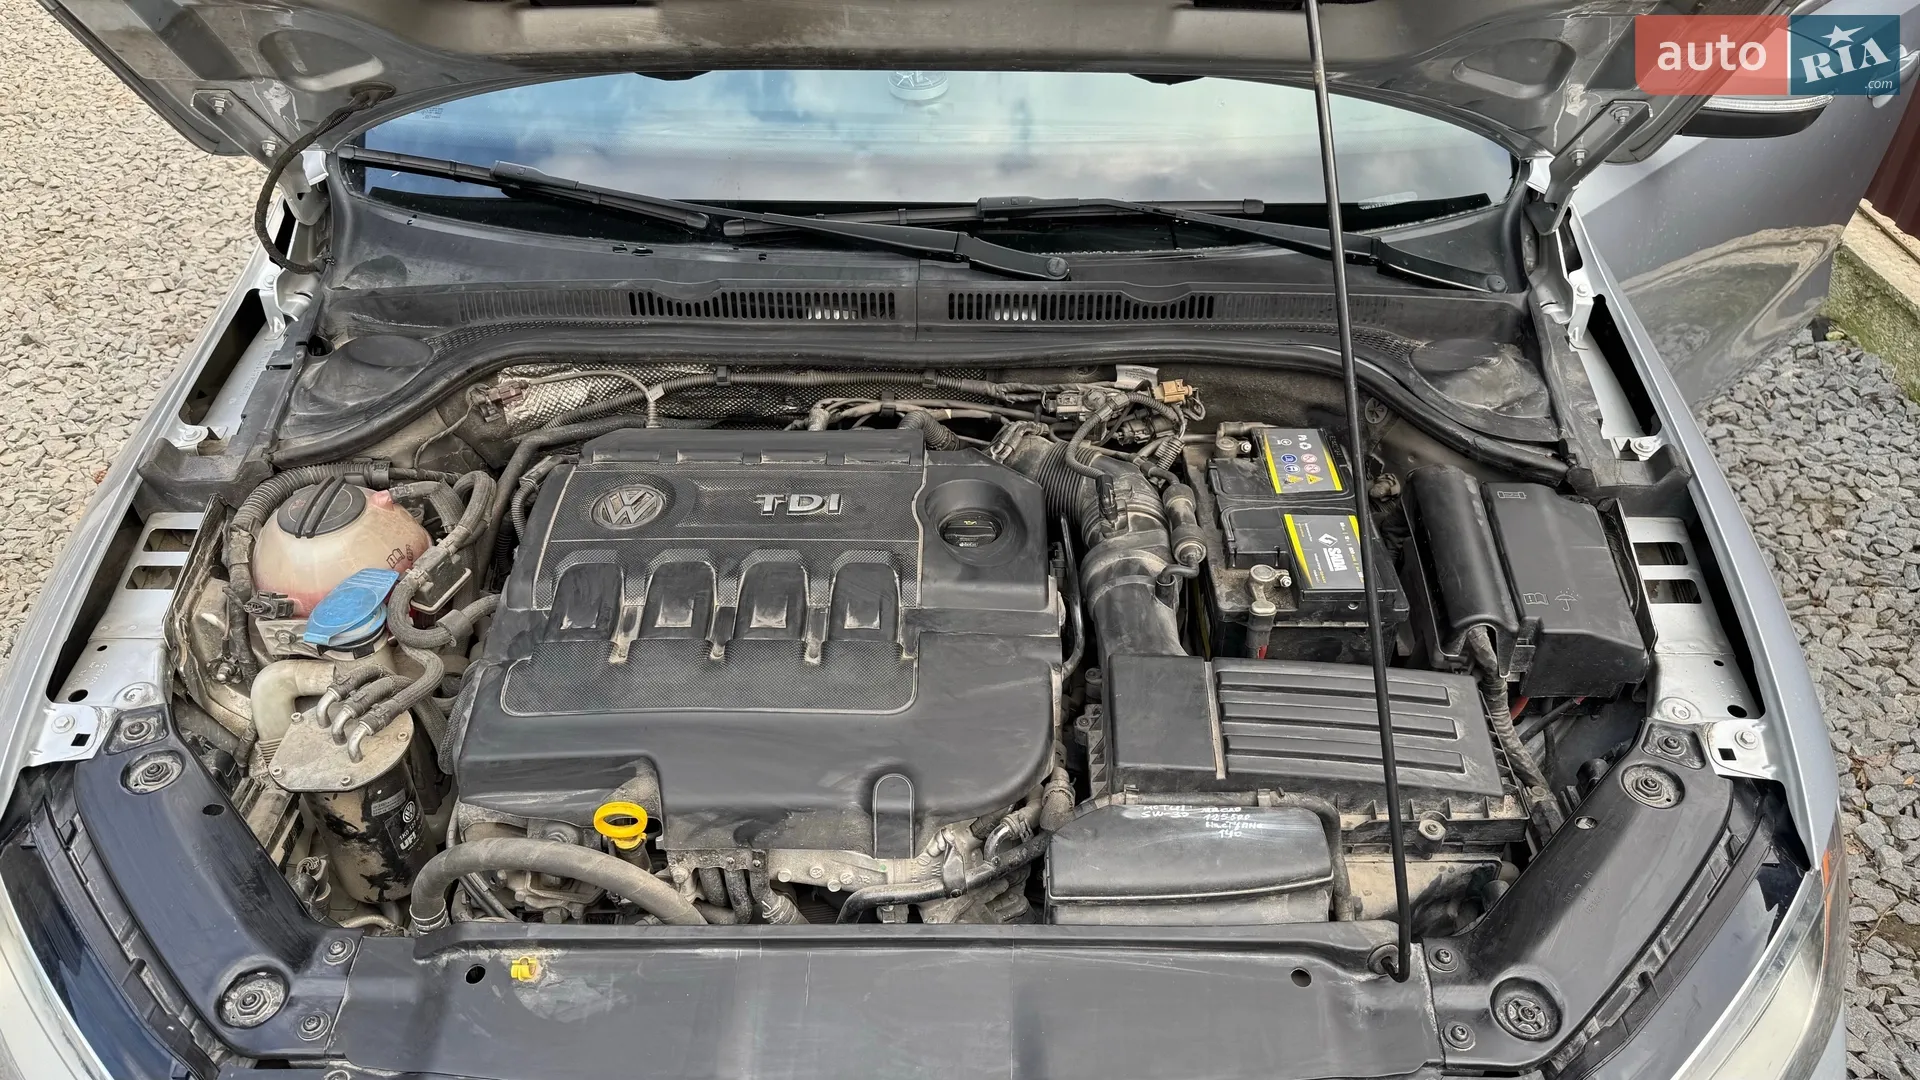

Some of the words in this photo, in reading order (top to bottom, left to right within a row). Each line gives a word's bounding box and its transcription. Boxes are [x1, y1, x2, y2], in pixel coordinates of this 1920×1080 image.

[756, 493, 843, 515] TDI
[1329, 547, 1347, 572] SADA
[399, 831, 417, 851] UFI
